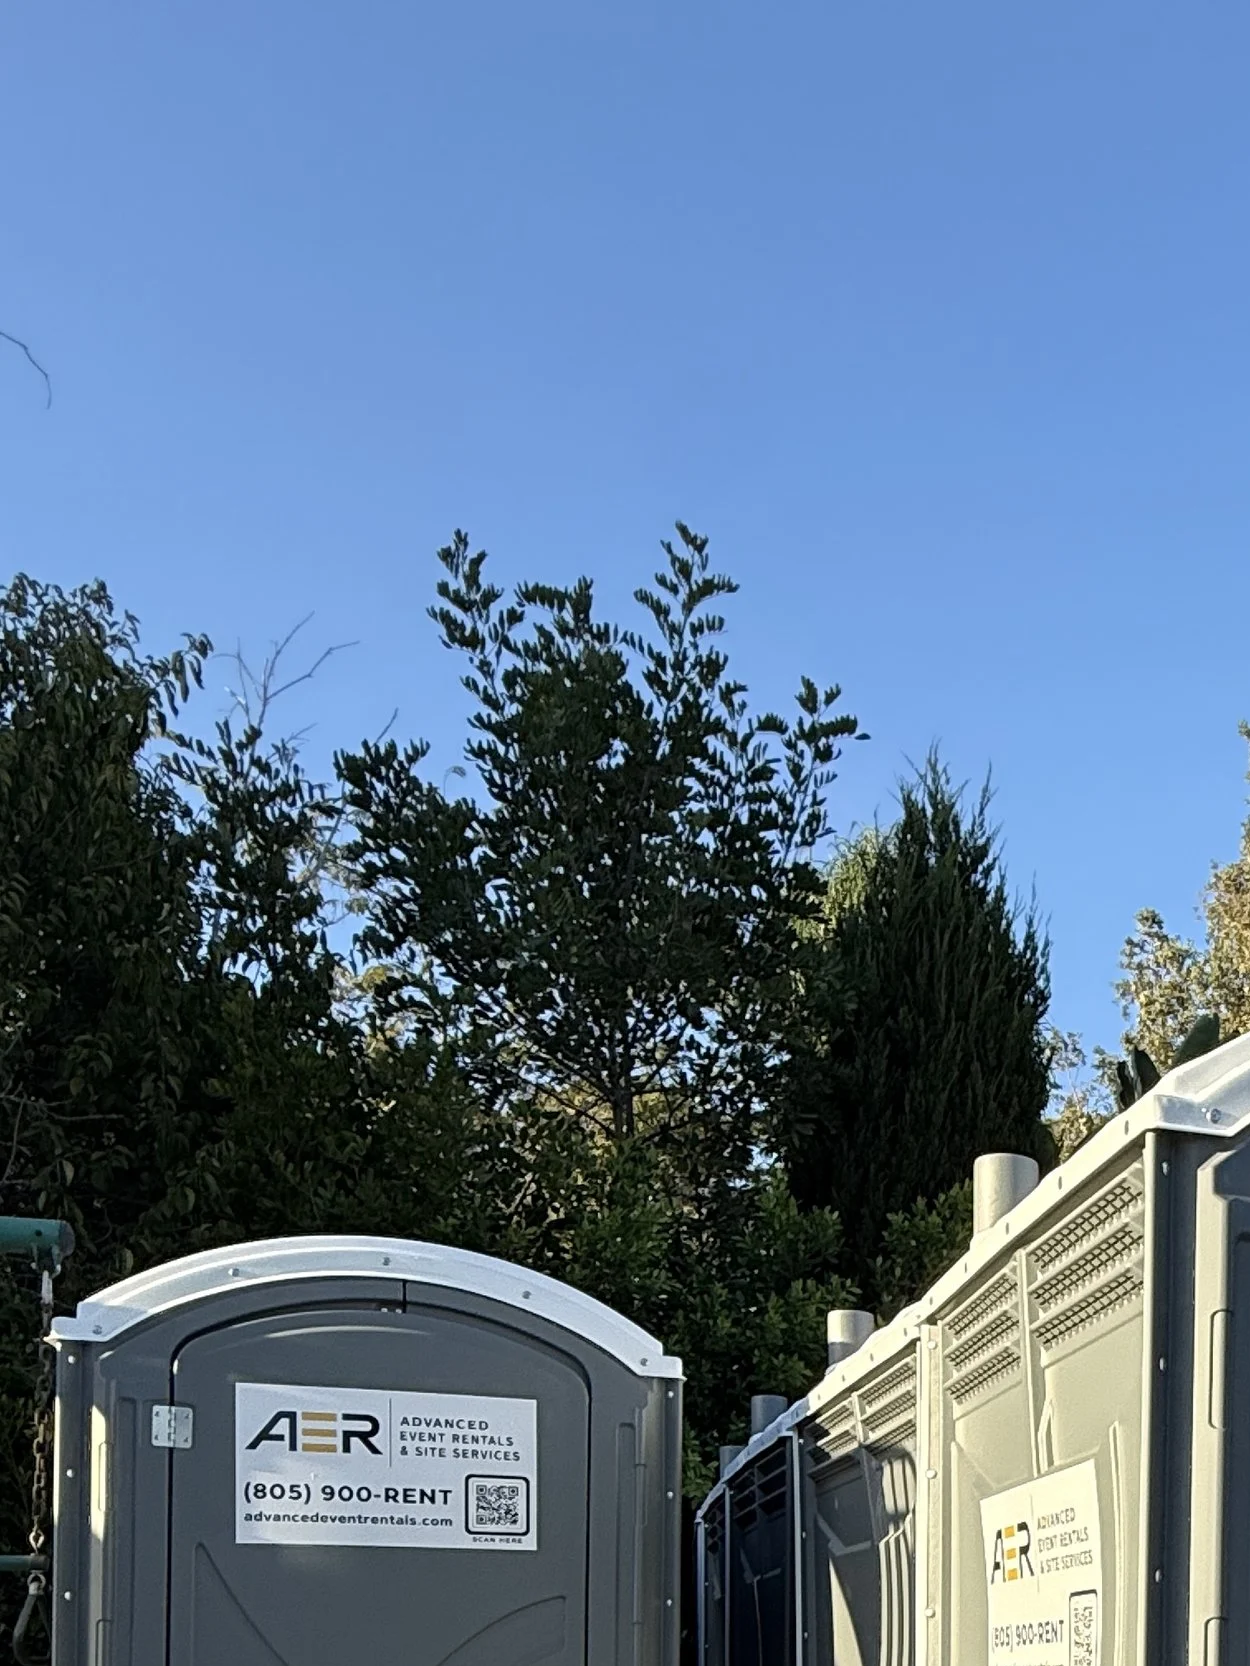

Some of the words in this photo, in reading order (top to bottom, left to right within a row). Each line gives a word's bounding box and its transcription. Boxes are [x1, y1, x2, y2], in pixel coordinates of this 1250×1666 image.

[244, 1410, 383, 1456] AER
[400, 1416, 489, 1431] ADVANCED
[399, 1431, 445, 1444] EVENT
[452, 1433, 514, 1447] RENTALS
[399, 1446, 408, 1456] &
[415, 1446, 446, 1458] SITE
[452, 1449, 521, 1462] SERVICES
[243, 1482, 311, 1505] (805)
[321, 1485, 453, 1505] 900-RENT
[243, 1510, 453, 1527] advancedeventrentals.com
[1037, 1507, 1076, 1530] ADVANCED
[1038, 1533, 1058, 1553] EVENT
[1059, 1526, 1089, 1548] RENTALS
[990, 1521, 1035, 1585] AER
[1046, 1556, 1060, 1573] SITE
[1061, 1550, 1094, 1571] SERVICES
[991, 1624, 1014, 1654] (805)
[1015, 1620, 1064, 1647] 900-RENT
